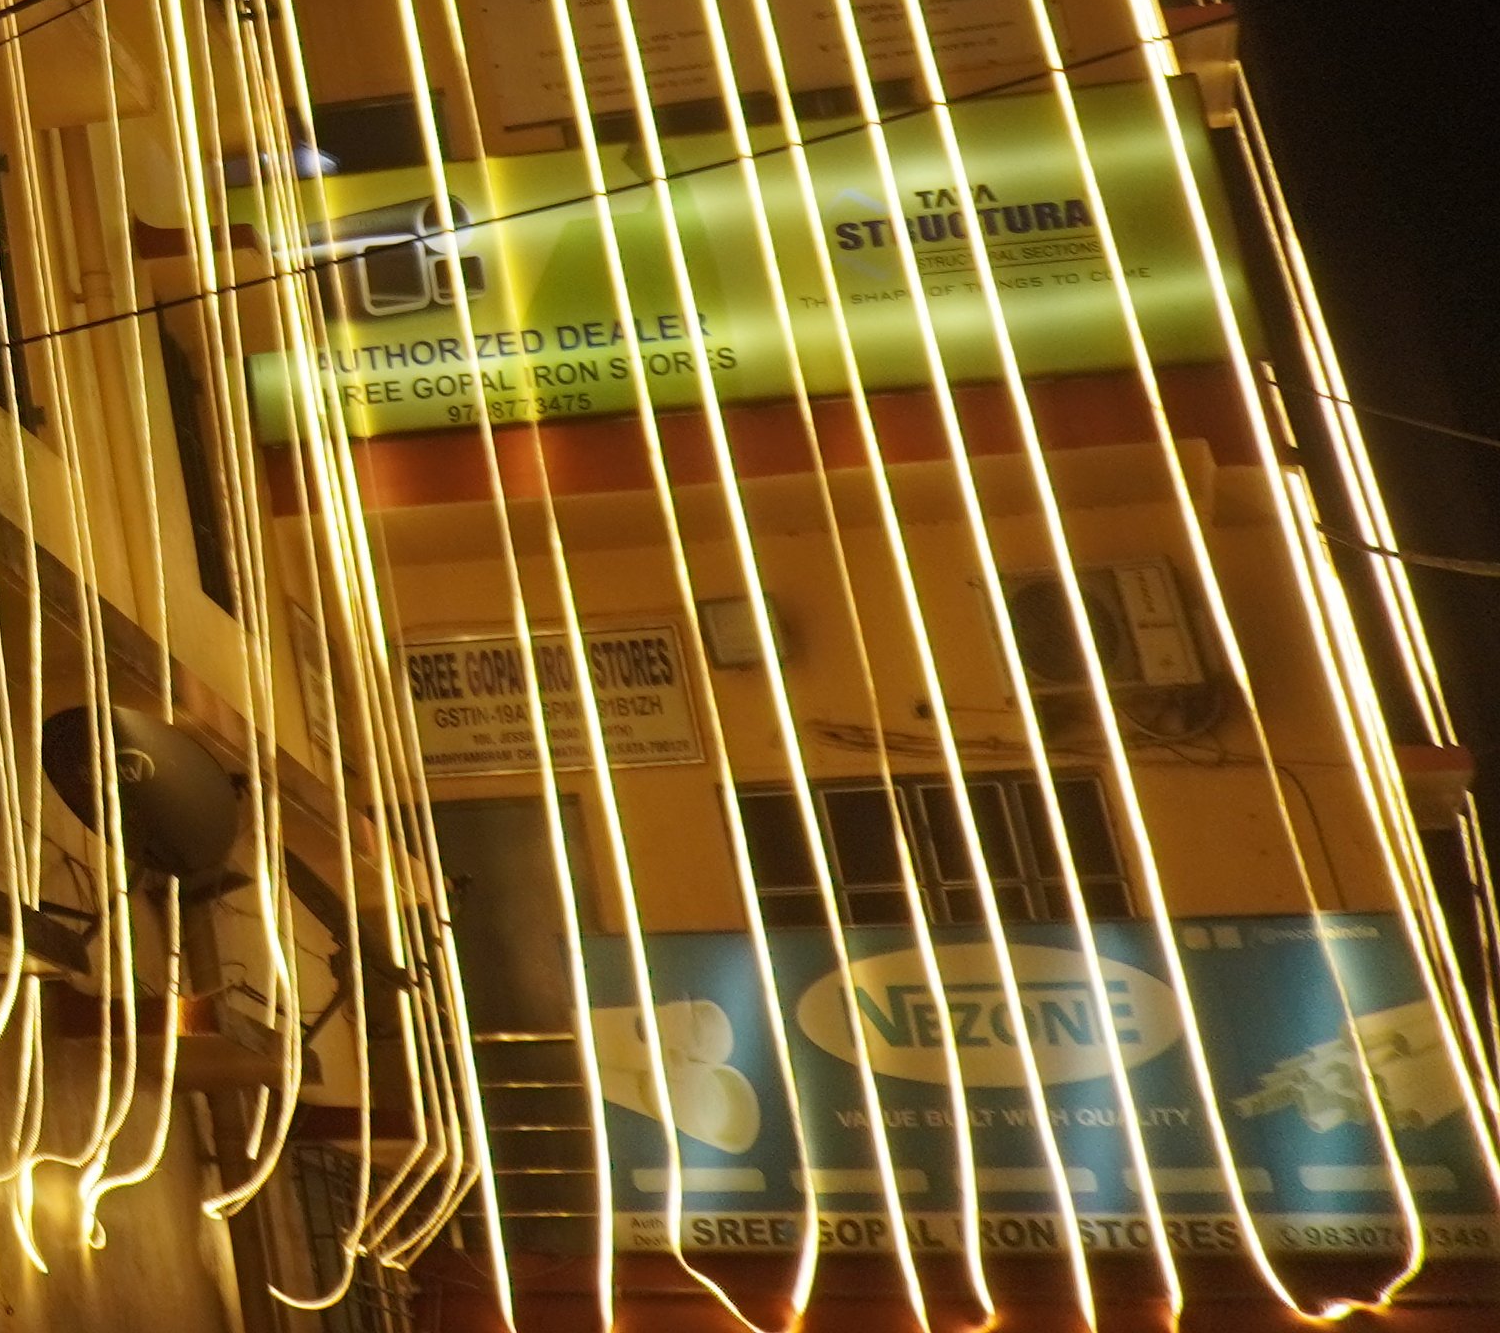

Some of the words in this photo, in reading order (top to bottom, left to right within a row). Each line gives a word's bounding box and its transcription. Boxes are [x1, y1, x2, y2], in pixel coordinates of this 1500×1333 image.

[317, 327, 545, 374] AUTHORZED
[412, 369, 517, 401] GOPAL
[447, 392, 592, 424] 978773475
[408, 652, 464, 702] SREE
[464, 646, 529, 698] GOPA
[590, 636, 674, 688] STORES
[839, 980, 1142, 1049] NEZONE
[836, 1109, 919, 1129] VAUE
